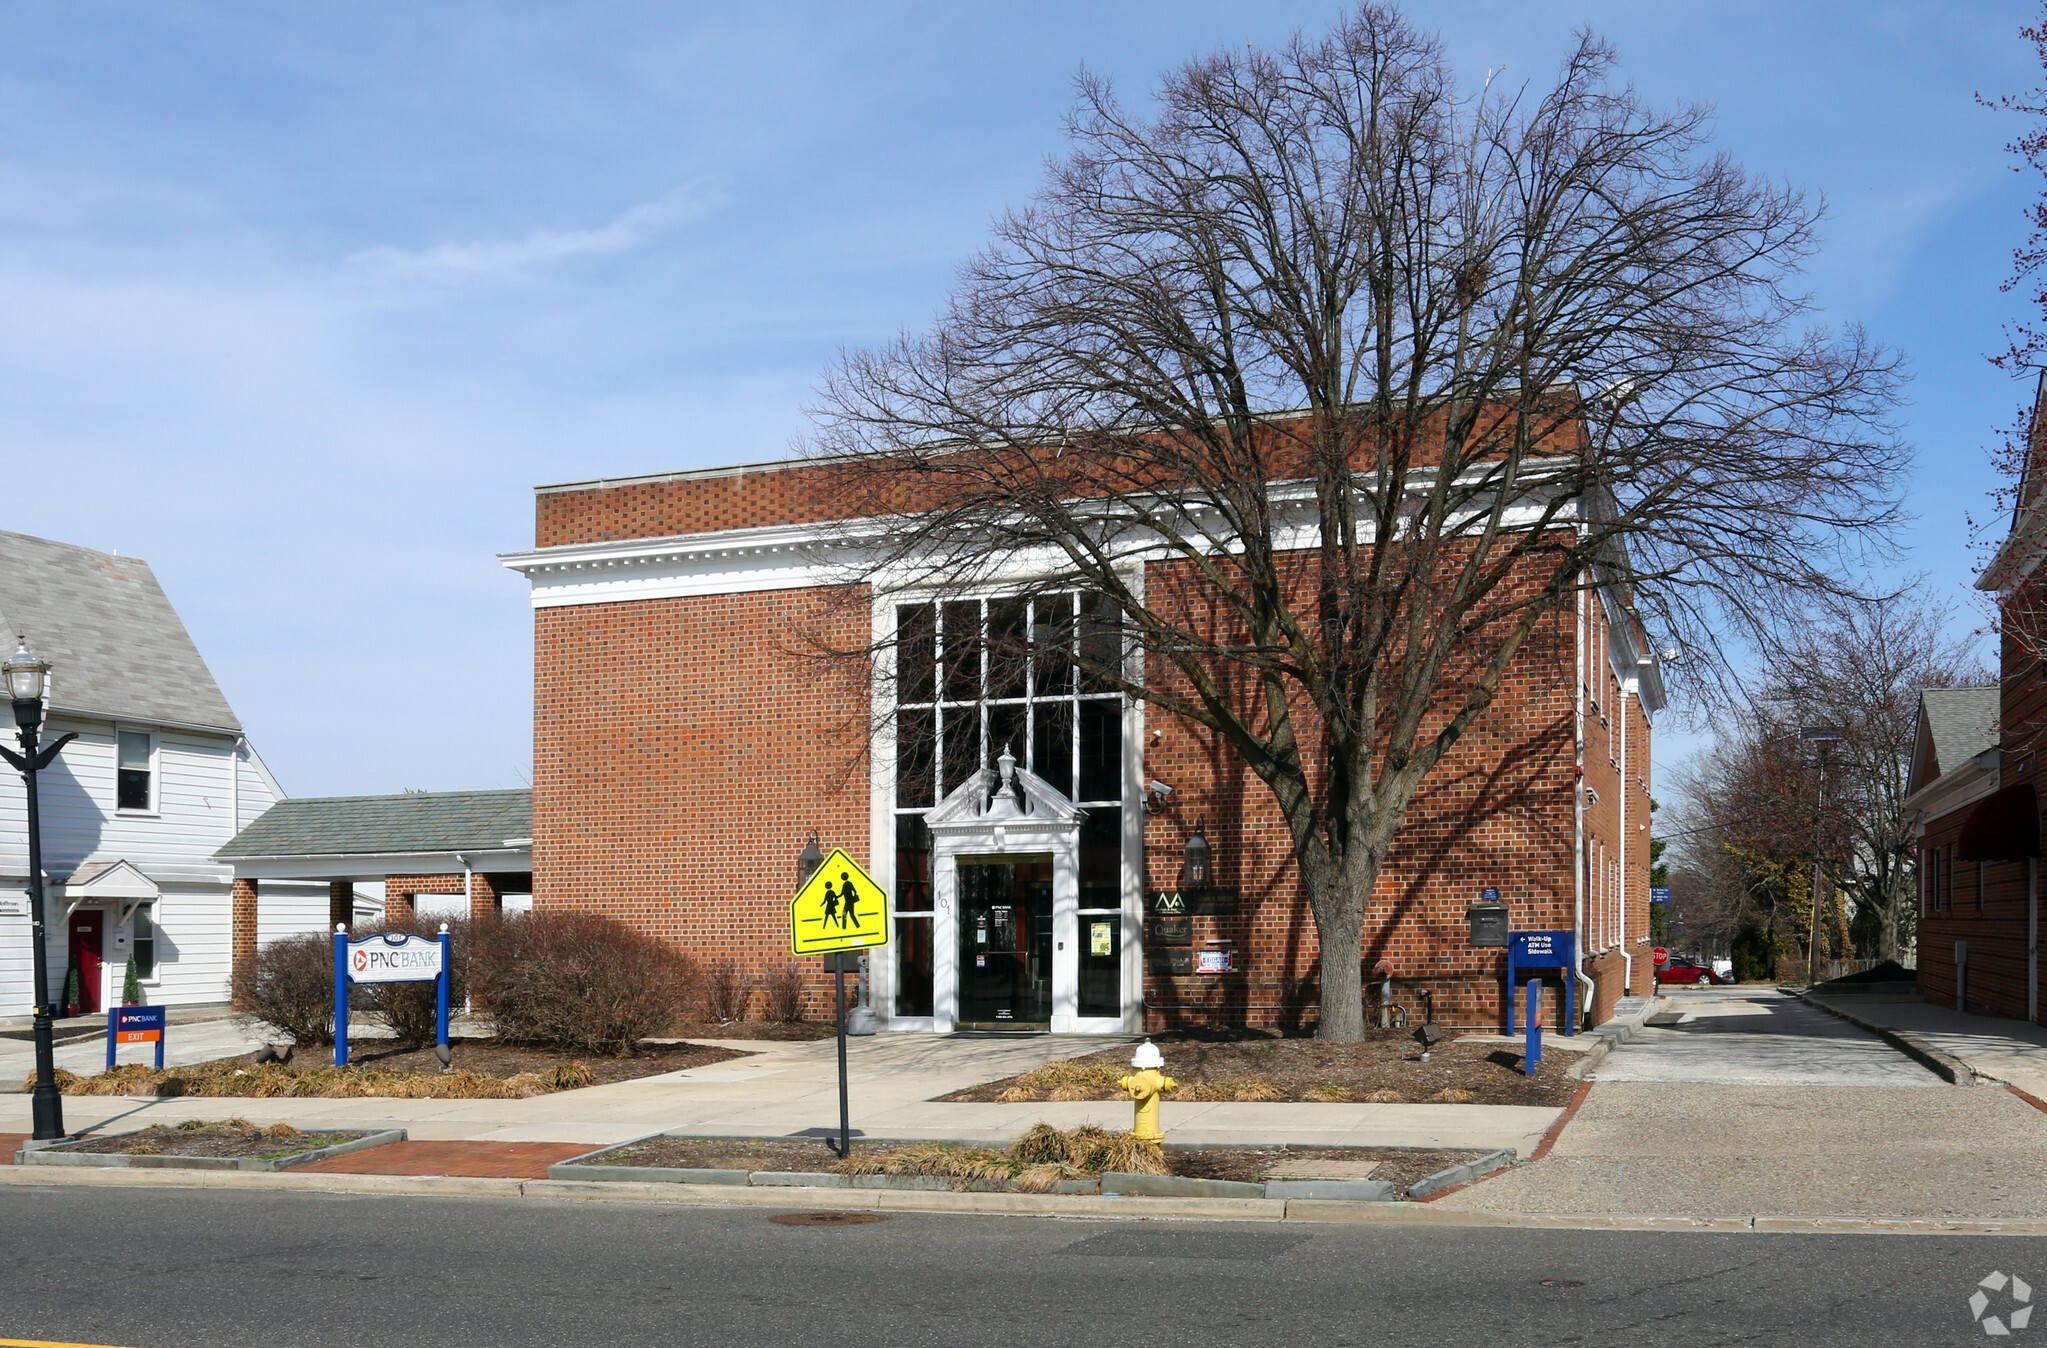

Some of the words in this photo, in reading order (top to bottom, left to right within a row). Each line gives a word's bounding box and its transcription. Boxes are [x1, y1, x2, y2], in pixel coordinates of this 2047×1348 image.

[937, 890, 951, 915] 101
[1155, 924, 1187, 937] Quaker
[1527, 935, 1552, 943] Walk-Up
[127, 1032, 144, 1041] EXIT
